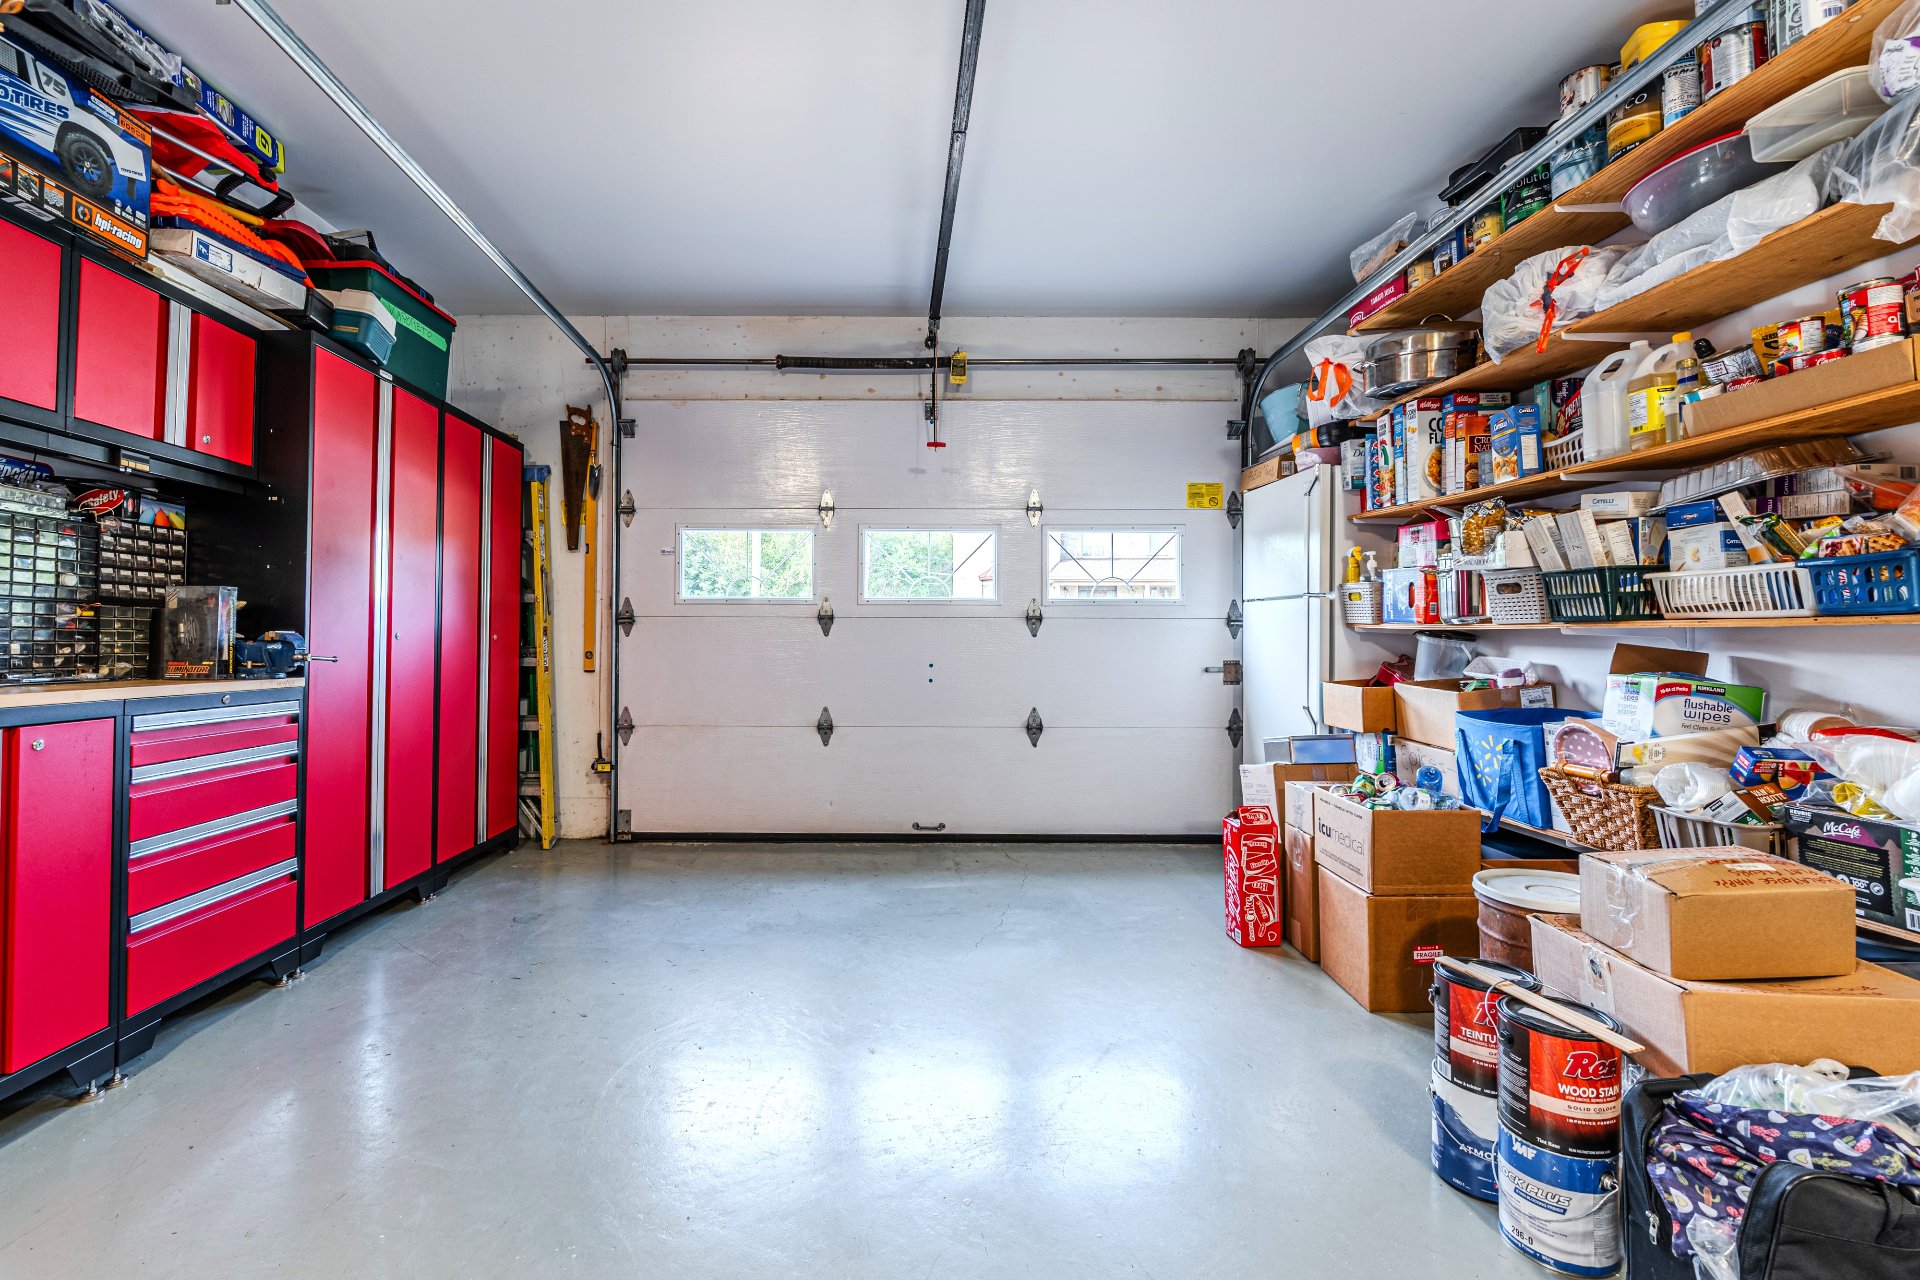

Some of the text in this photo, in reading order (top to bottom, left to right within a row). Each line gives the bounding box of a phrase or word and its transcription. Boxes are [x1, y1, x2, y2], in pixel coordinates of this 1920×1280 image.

[41, 71, 66, 97] 75
[1419, 400, 1441, 409] Kellogg's
[1456, 394, 1478, 404] Kellogg's
[1697, 685, 1725, 694] KIRKLAND
[1683, 698, 1734, 714] flushable
[1683, 709, 1732, 723] wipes
[1749, 788, 1769, 797] VAN
[1757, 792, 1788, 804] HOUTTE
[1789, 808, 1813, 817] KEURIG
[1244, 897, 1257, 922] Coke
[1415, 951, 1442, 959] FRAGILE
[1557, 1082, 1620, 1099] WOOD STAIN
[1567, 1104, 1617, 1113] SOLID COLOUR
[1566, 1118, 1596, 1126] IMPROVED
[1526, 1182, 1573, 1208] PLUS
[1511, 1225, 1534, 1246] 296-0
